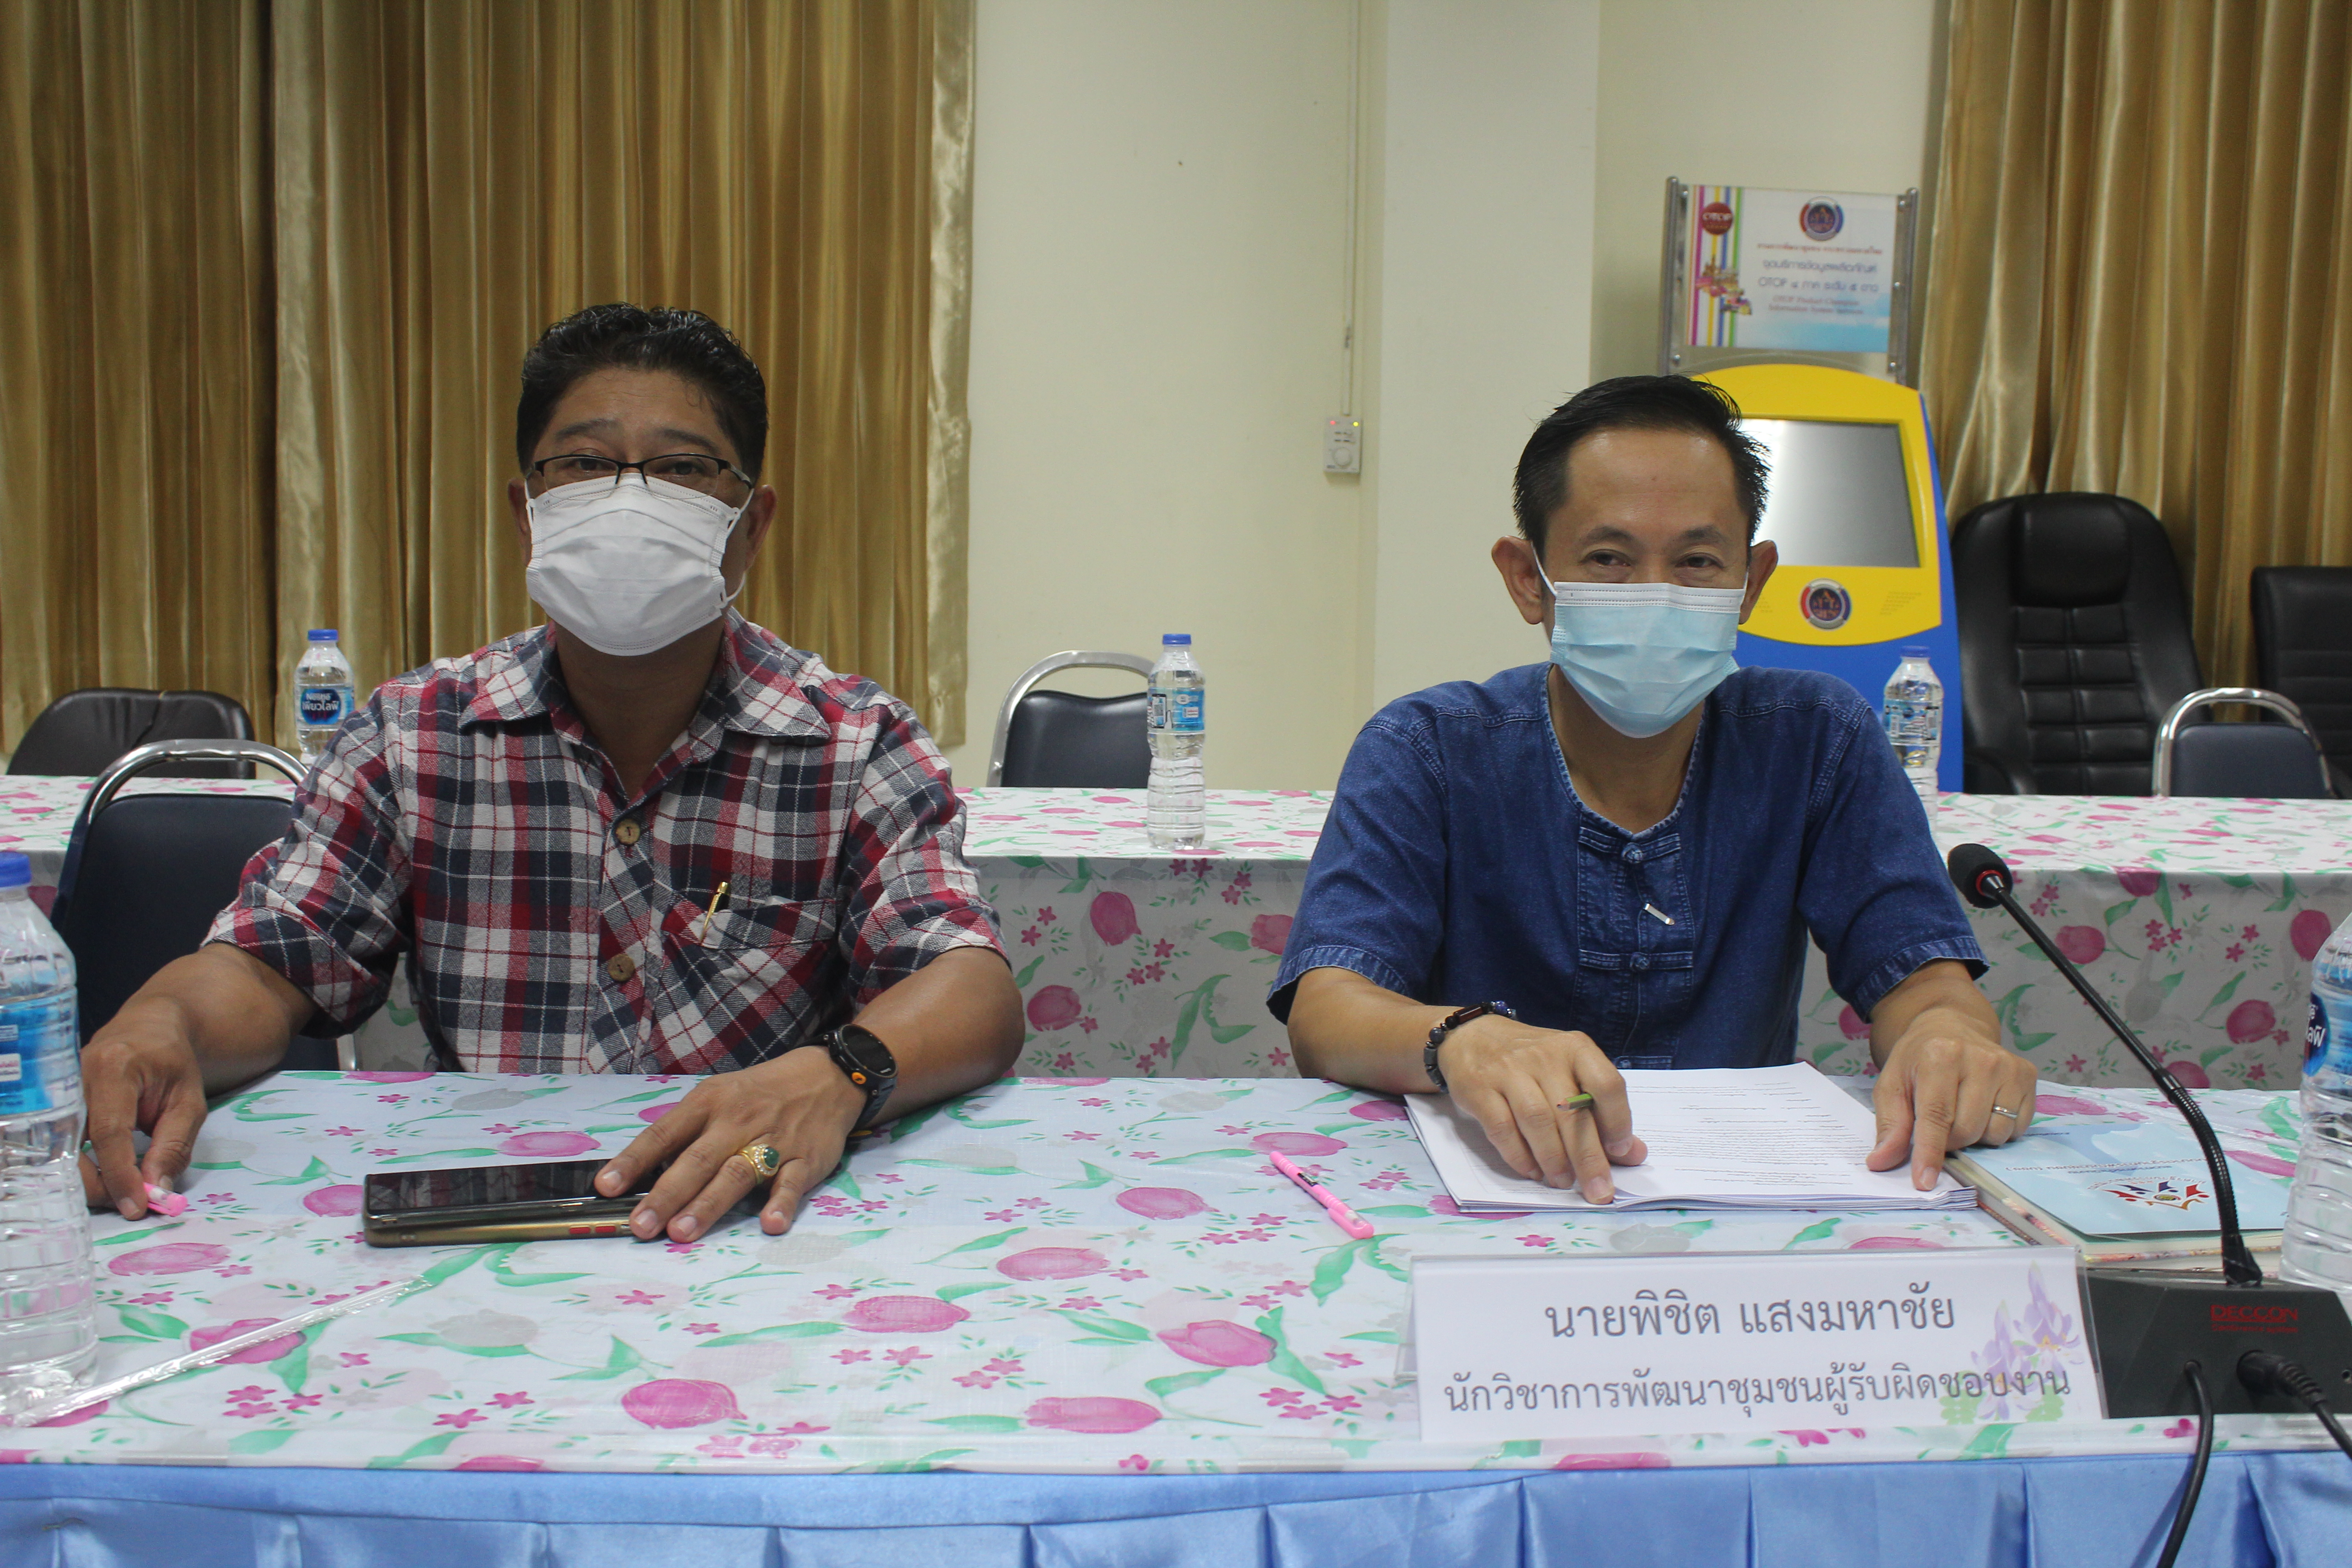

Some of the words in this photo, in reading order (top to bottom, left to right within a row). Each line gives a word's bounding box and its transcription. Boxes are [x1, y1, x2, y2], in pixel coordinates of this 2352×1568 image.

[1544, 1289, 1721, 1338] นายพิชิต
[1739, 1281, 1956, 1334] แสงมหาชัย
[2210, 1304, 2298, 1321] DECCON
[1444, 1361, 2072, 1417] นักวิชาการพัฒนาชุมชนผู้รับผิดชอบงาน
